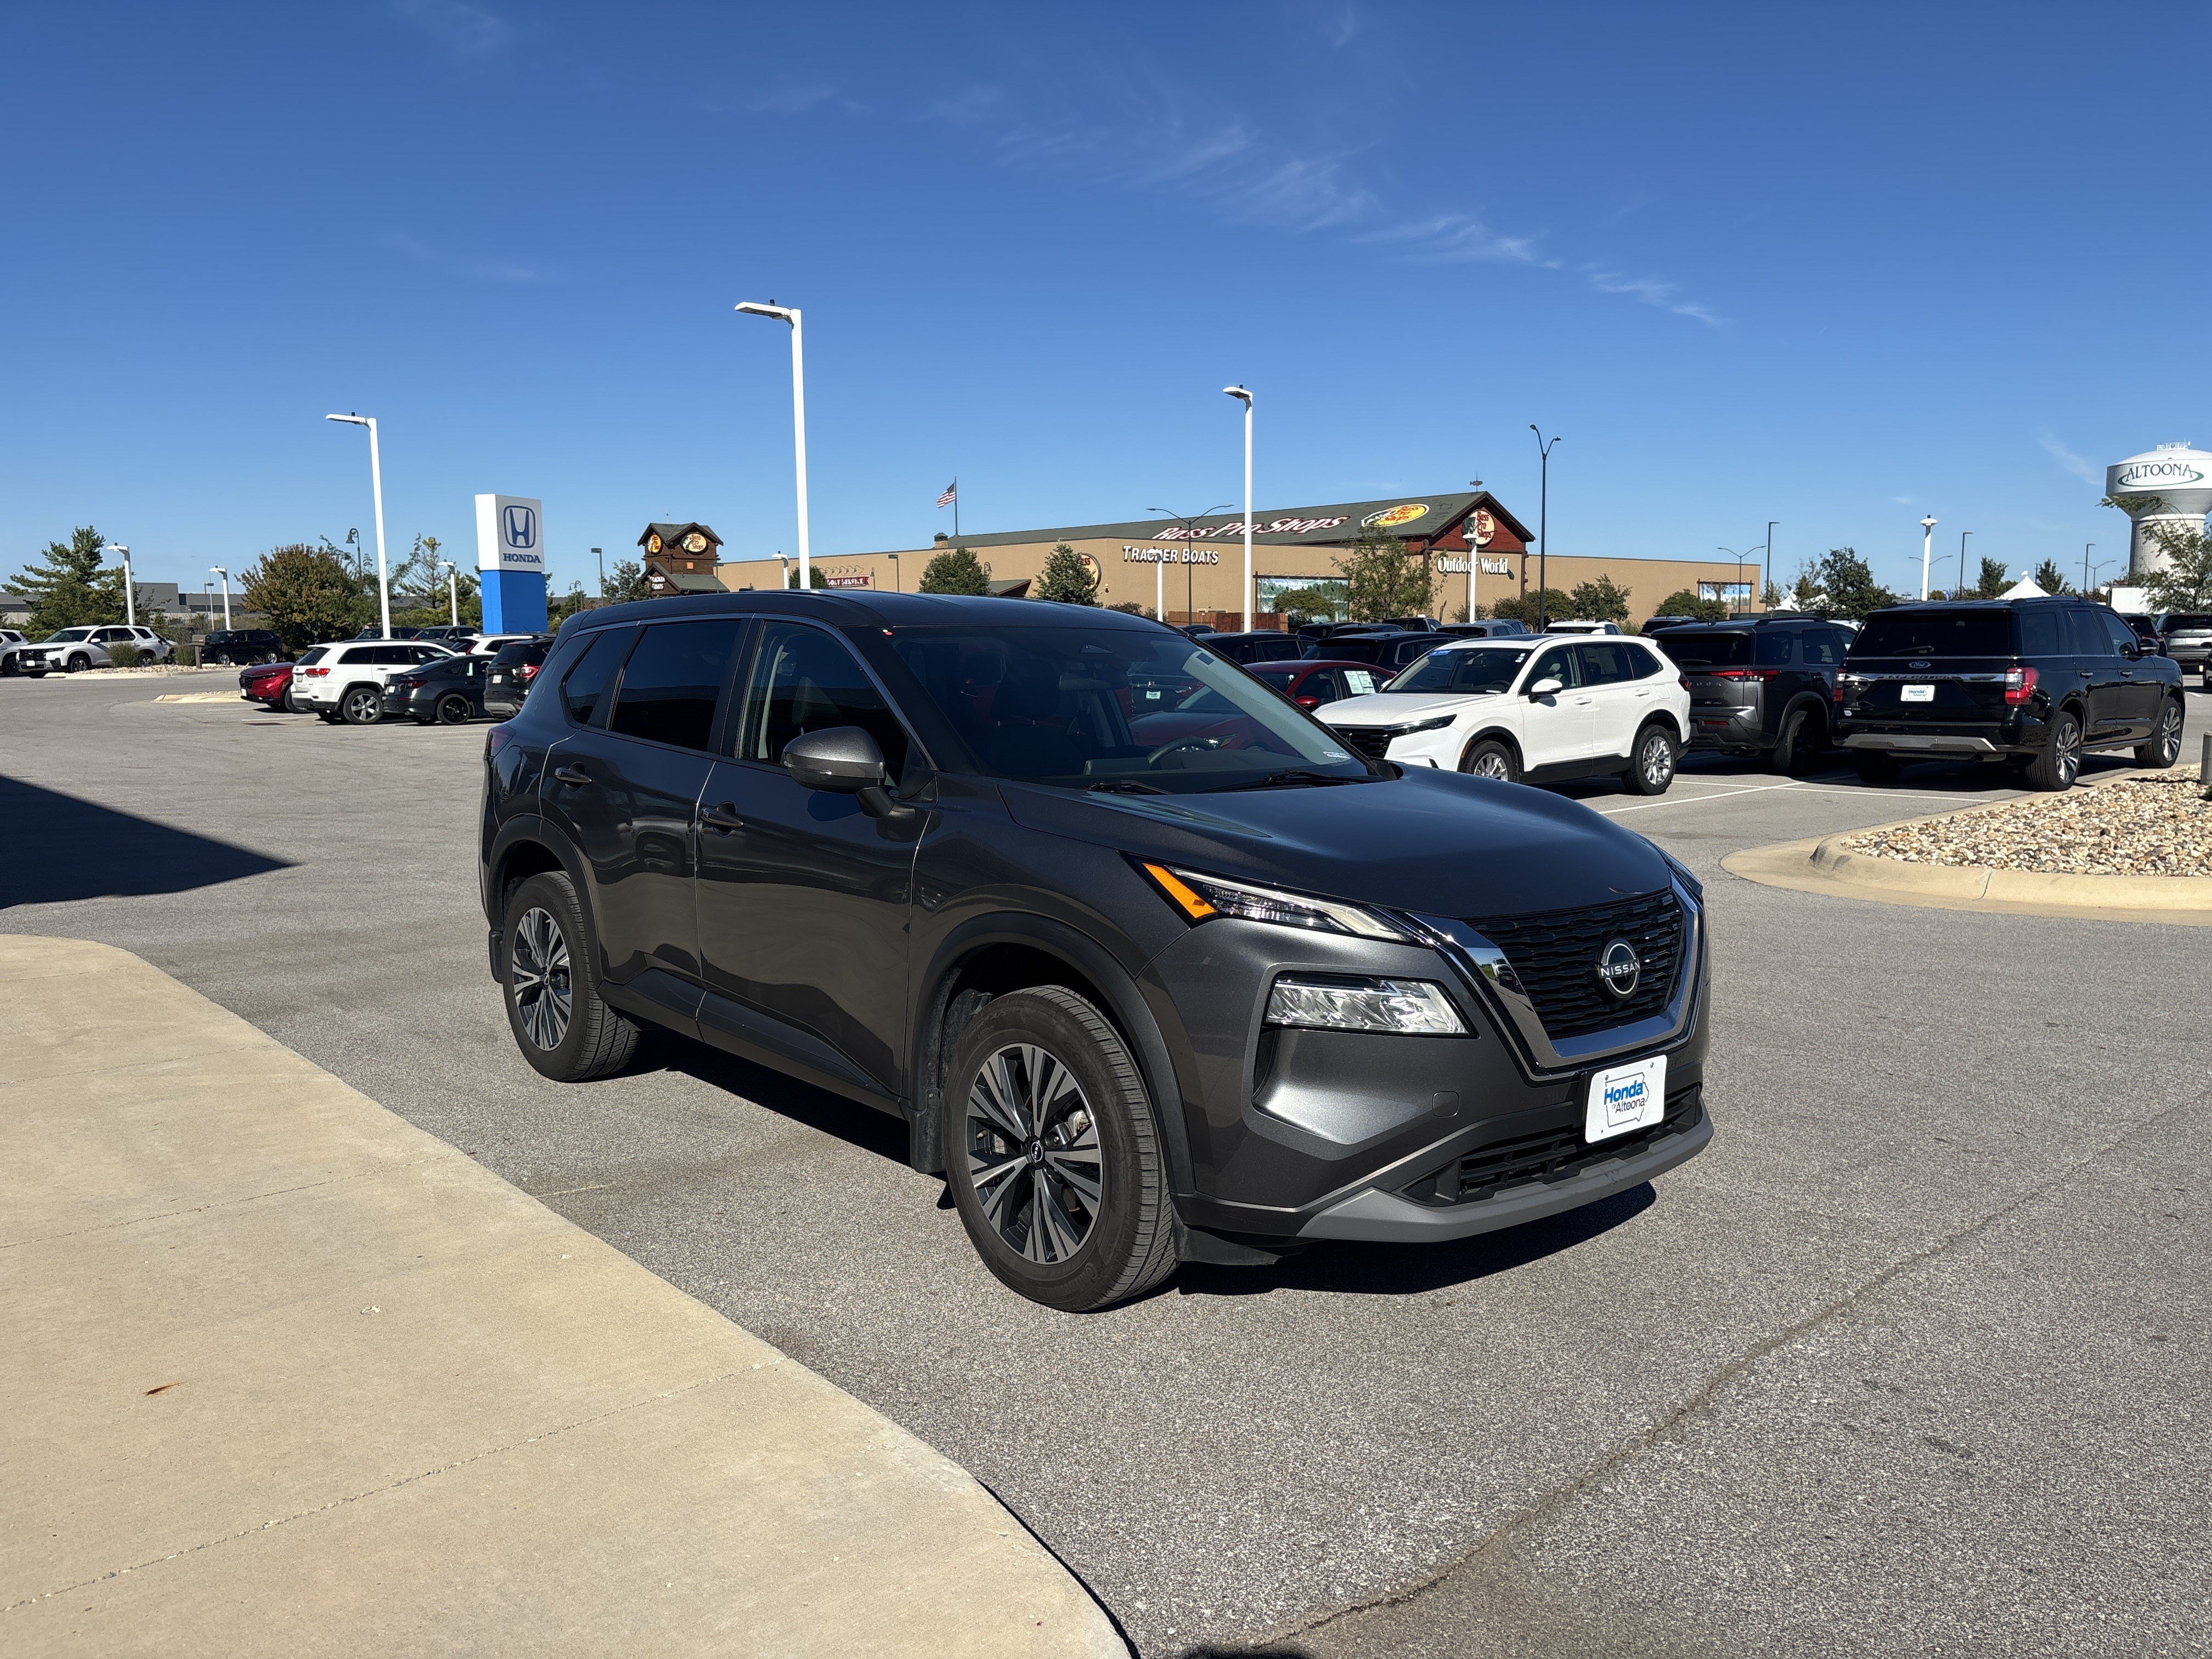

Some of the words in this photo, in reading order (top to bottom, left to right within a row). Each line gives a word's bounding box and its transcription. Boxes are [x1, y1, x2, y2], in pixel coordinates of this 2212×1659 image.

[2125, 464, 2193, 482] ALTOONA
[1477, 511, 1489, 521] Bass
[1151, 527, 1216, 540] Bass
[1206, 521, 1262, 537] Pro
[1257, 515, 1351, 535] Shops
[1477, 521, 1487, 532] Pro
[1477, 529, 1492, 540] Shops
[503, 553, 541, 563] HONDA
[1182, 548, 1219, 563] BOATS
[1480, 557, 1508, 573] World
[1600, 962, 1640, 977] NISSAN
[1604, 1080, 1644, 1105] Honda
[1615, 1097, 1645, 1114] Altoona
